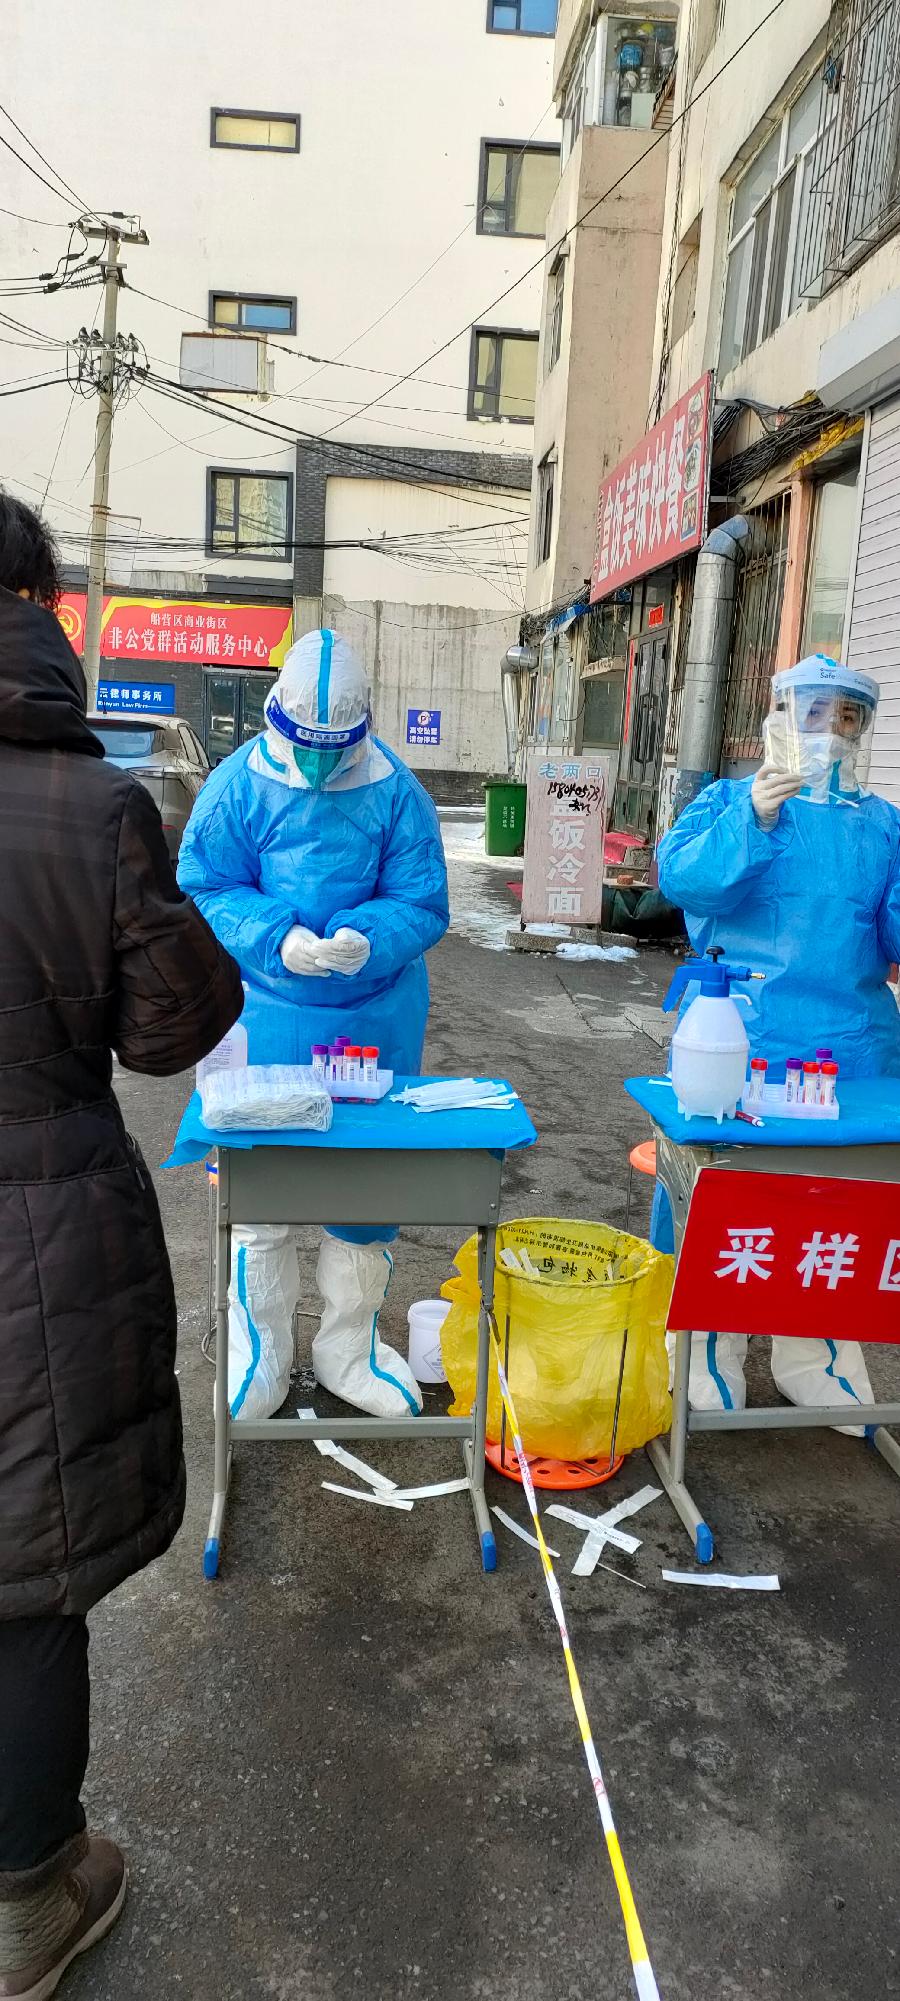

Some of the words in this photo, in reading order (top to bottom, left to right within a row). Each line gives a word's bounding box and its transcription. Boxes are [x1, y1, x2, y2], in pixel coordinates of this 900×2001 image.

[150, 612, 228, 629] 船营区商业街区
[108, 626, 268, 657] 非公党群活动服务中心
[539, 762, 602, 780] 老两口
